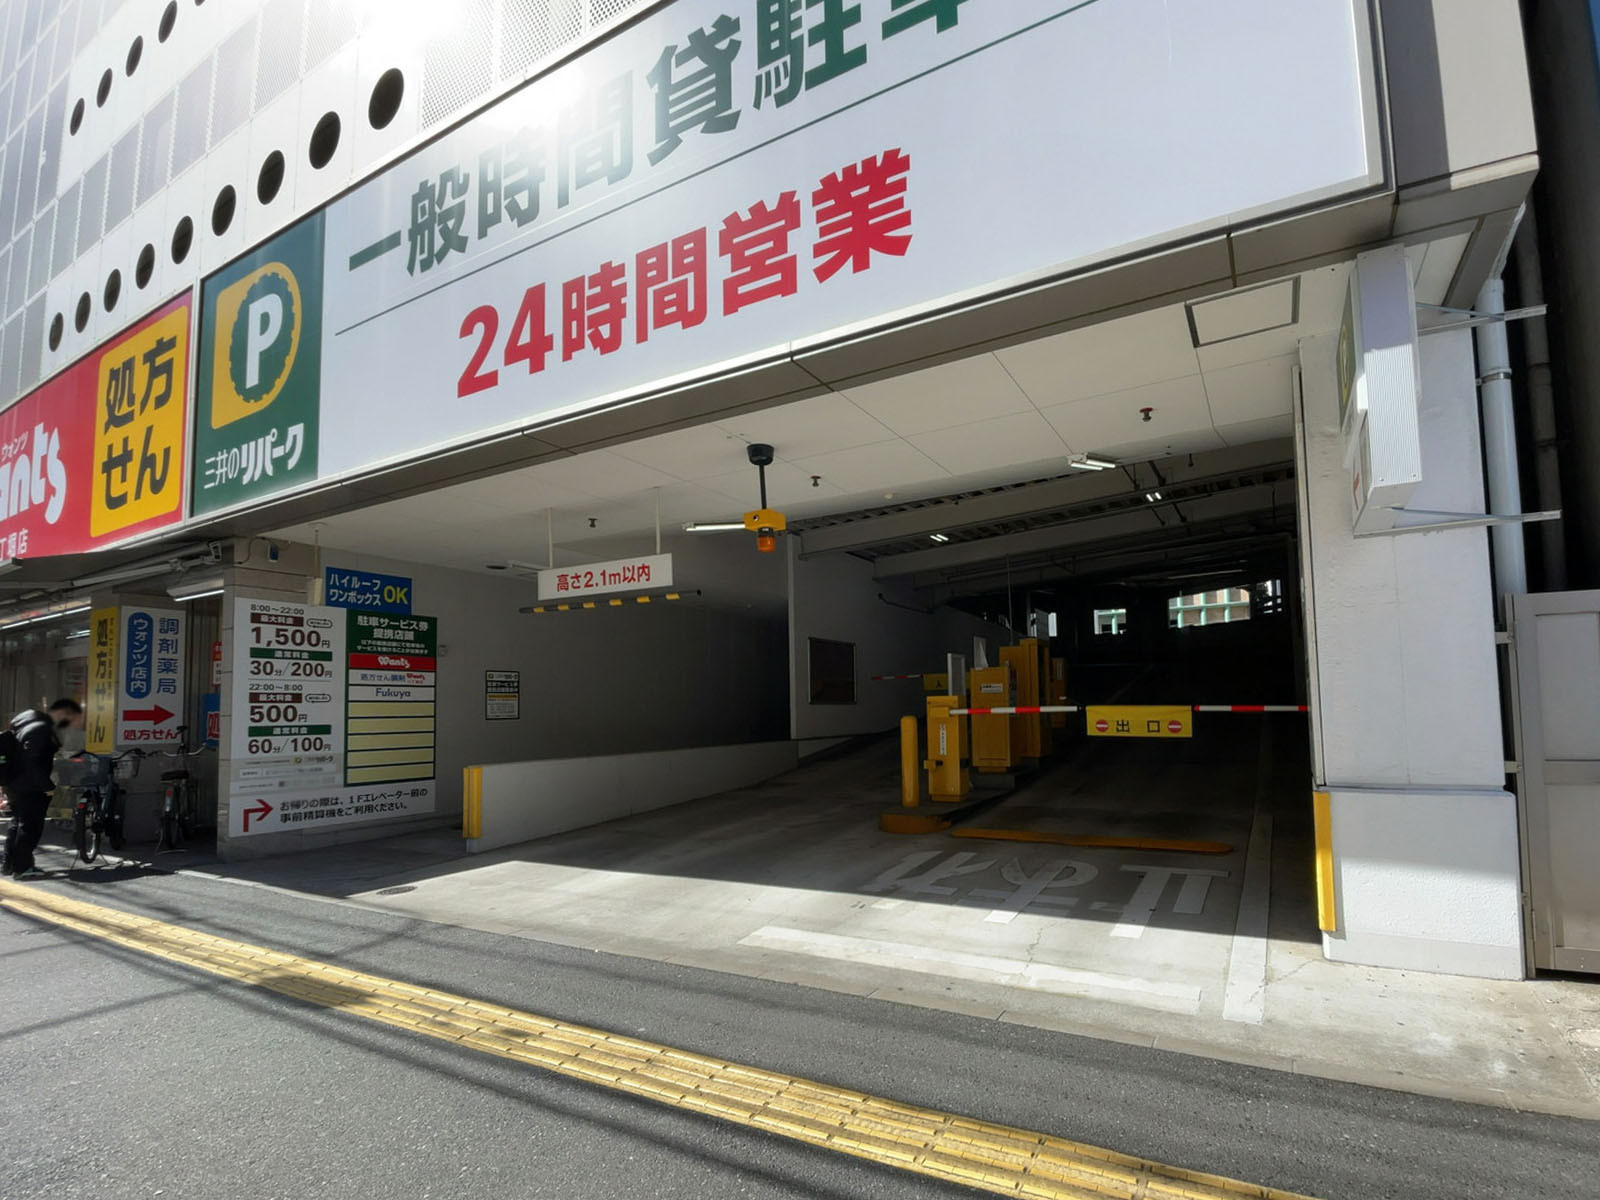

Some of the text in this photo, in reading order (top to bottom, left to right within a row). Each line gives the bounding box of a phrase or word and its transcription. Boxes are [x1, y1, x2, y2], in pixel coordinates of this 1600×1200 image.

[348, 0, 969, 278] 一般時間貸駐
[457, 148, 913, 399] 24時間営業
[246, 293, 283, 389] P
[104, 335, 177, 435] 処方
[101, 425, 171, 511] せん
[204, 423, 304, 489] 三井のリパーク
[330, 573, 381, 591] ハイルーフ
[556, 563, 651, 592] 高さ2.1m以内
[329, 588, 382, 606] ワンボックス
[383, 585, 409, 605] OK
[251, 626, 330, 648] 1,500円
[130, 618, 150, 693] ウォンツ店内
[156, 617, 180, 695] 調剤薬局
[378, 656, 411, 669] Wants
[375, 688, 412, 699] Fukuya
[249, 704, 308, 723] 500円
[1116, 719, 1160, 733] 出口
